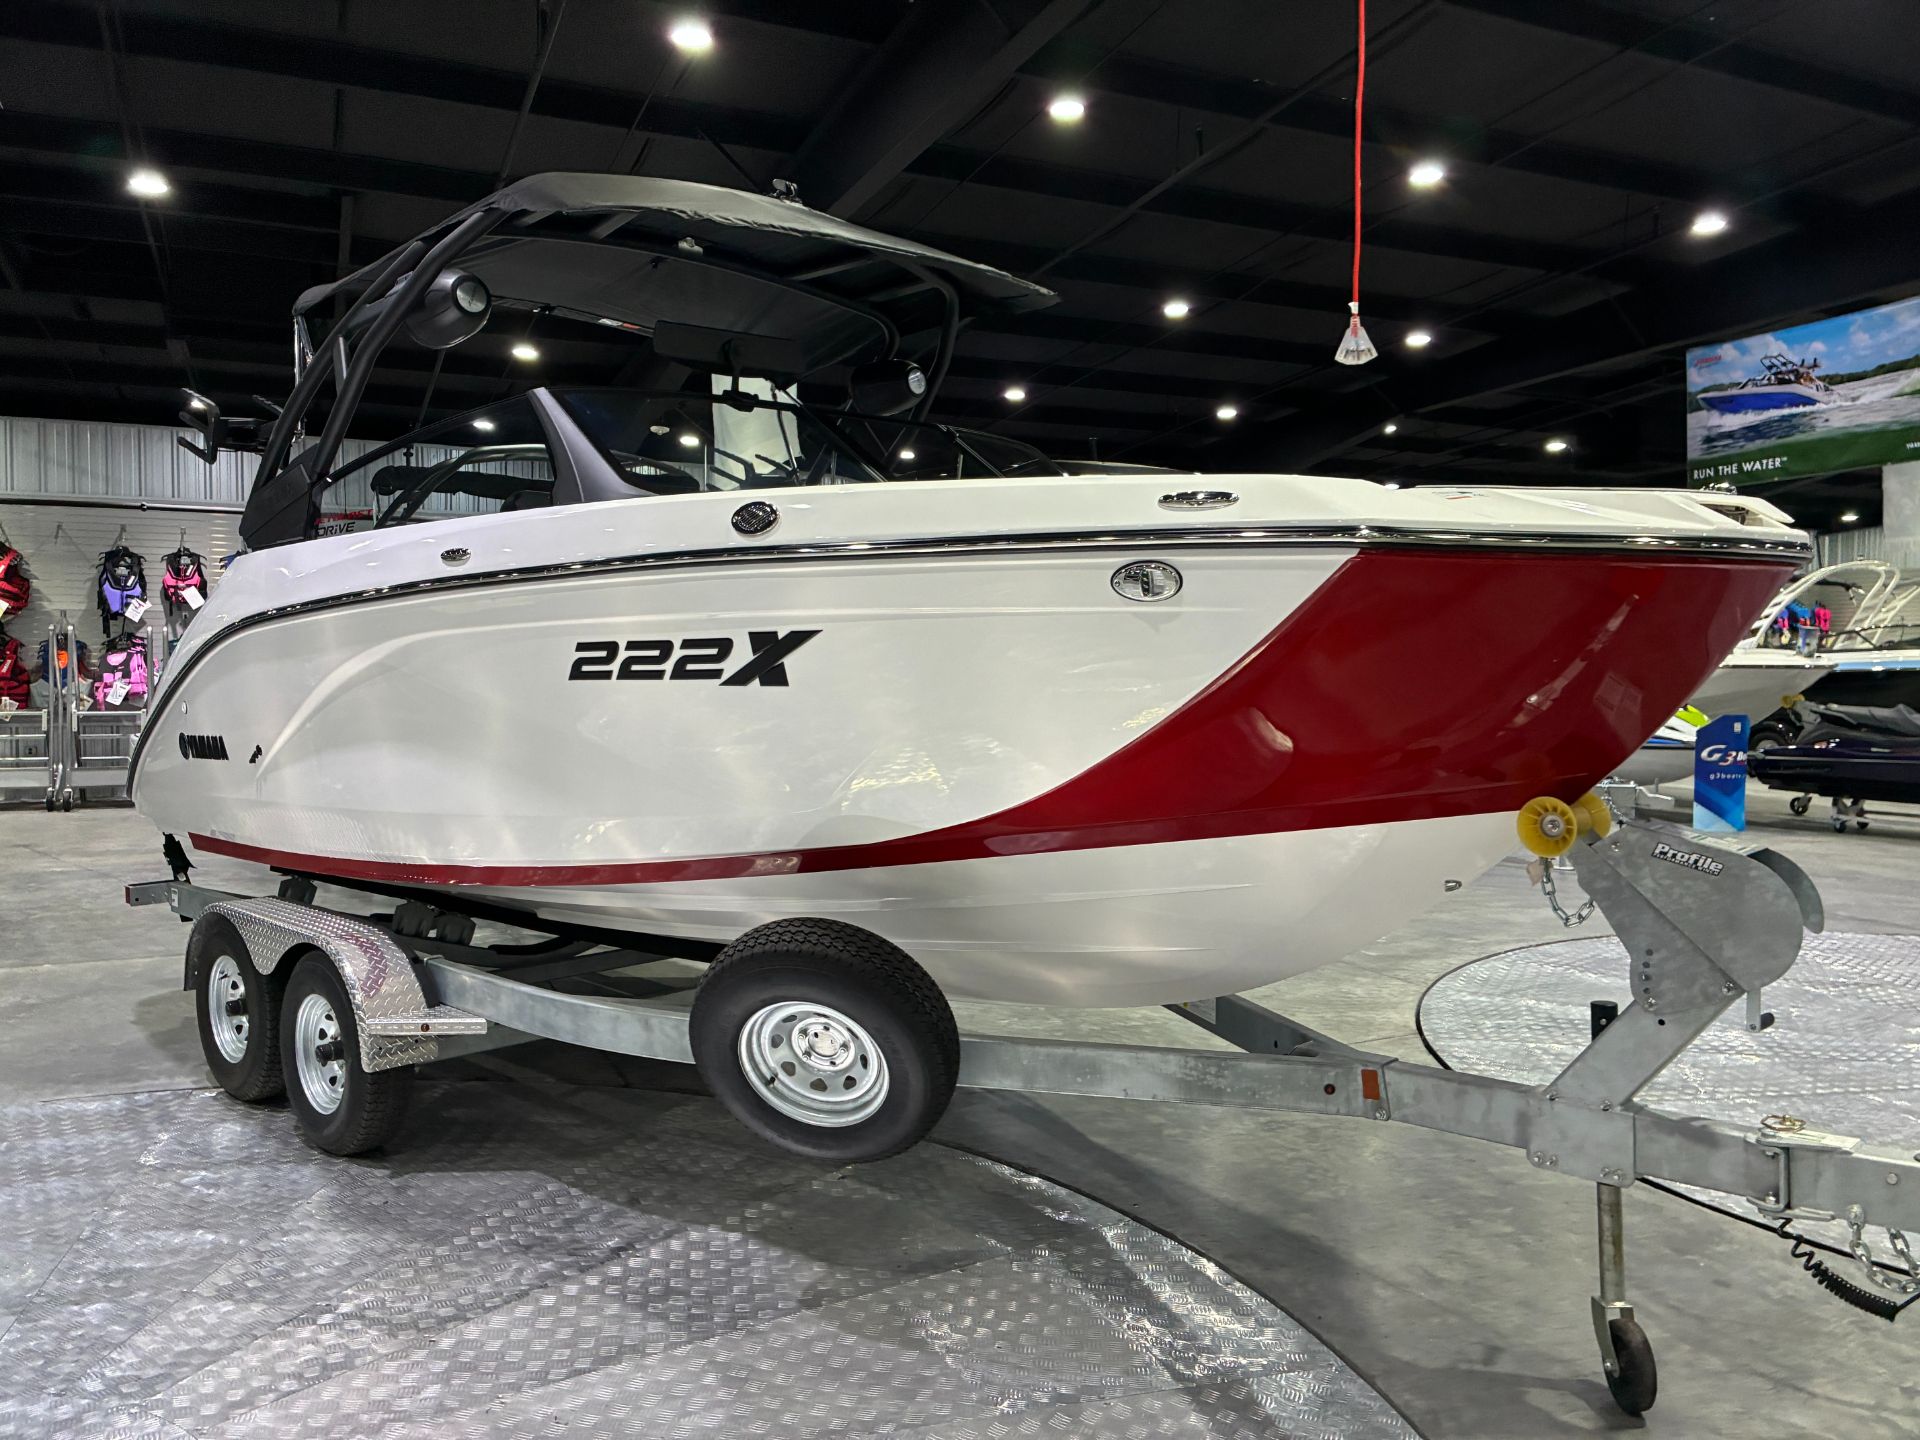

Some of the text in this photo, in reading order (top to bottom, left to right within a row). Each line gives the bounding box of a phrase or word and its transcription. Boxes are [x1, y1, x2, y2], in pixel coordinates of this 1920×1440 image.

[1693, 467, 1714, 480] RUN
[1718, 463, 1738, 476] THE
[568, 629, 823, 687] 222X
[1653, 843, 1724, 870] Profile
